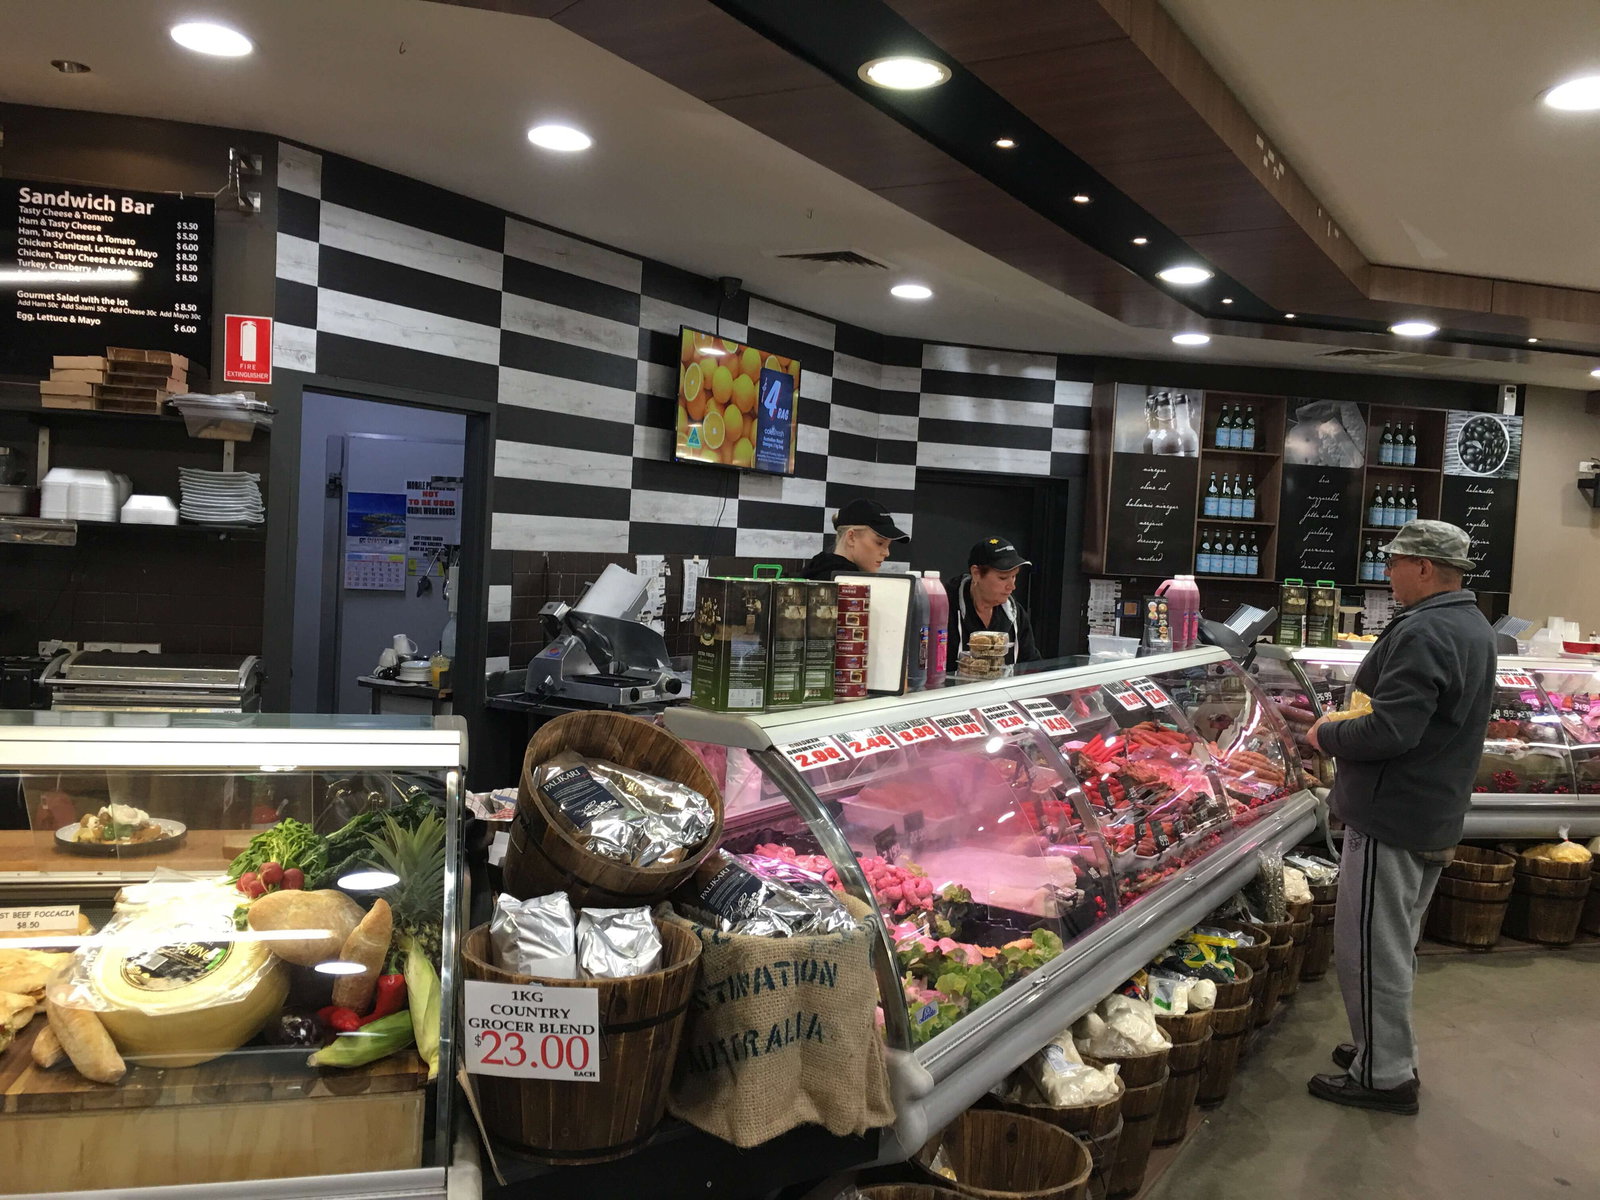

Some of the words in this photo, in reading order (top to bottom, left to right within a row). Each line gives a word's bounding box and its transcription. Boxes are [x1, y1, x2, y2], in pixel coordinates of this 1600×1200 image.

[19, 187, 116, 211] Sandwich
[121, 197, 155, 215] Bar
[19, 206, 40, 216] Tasty
[42, 208, 73, 219] Cheese
[74, 211, 81, 219] &
[82, 212, 114, 222] Tomato
[18, 216, 38, 226] Ham
[40, 218, 47, 226] &
[48, 219, 70, 230] Tasty
[71, 222, 102, 232] Cheese
[41, 229, 64, 240] Tasty
[65, 231, 95, 242] Cheese
[96, 234, 103, 242] &
[104, 235, 136, 246] Tomato
[17, 238, 51, 248] Chicken
[94, 245, 126, 255] Lettuce
[127, 248, 134, 256] &
[135, 248, 158, 259] Mayo
[54, 251, 77, 262] Tasty
[77, 253, 108, 264] Cheese
[109, 256, 116, 265] &
[117, 257, 154, 268] Avocado
[17, 290, 55, 301] Gourmet
[56, 292, 79, 302] Salad
[80, 295, 100, 304] with
[101, 296, 115, 306] the
[116, 297, 129, 307] lot
[31, 300, 47, 308] Ham
[75, 304, 96, 312] Salami
[110, 306, 123, 314] Add
[123, 307, 146, 316] Cheese
[160, 310, 172, 318] Add
[36, 312, 68, 323] Lettuce
[69, 315, 76, 323] &
[77, 315, 101, 326] Mayo
[226, 370, 269, 380] EXTINGUISHER
[239, 362, 257, 371] FIRE
[543, 769, 581, 792] PALIKARI
[700, 867, 730, 900] PALIKARI
[12, 911, 32, 919] BEEF
[34, 910, 75, 918] FOCCACIA
[511, 990, 544, 1003] 1KG
[490, 1004, 571, 1020] COUNTRY
[468, 1017, 535, 1033] GROCER
[539, 1023, 595, 1036] BLEND
